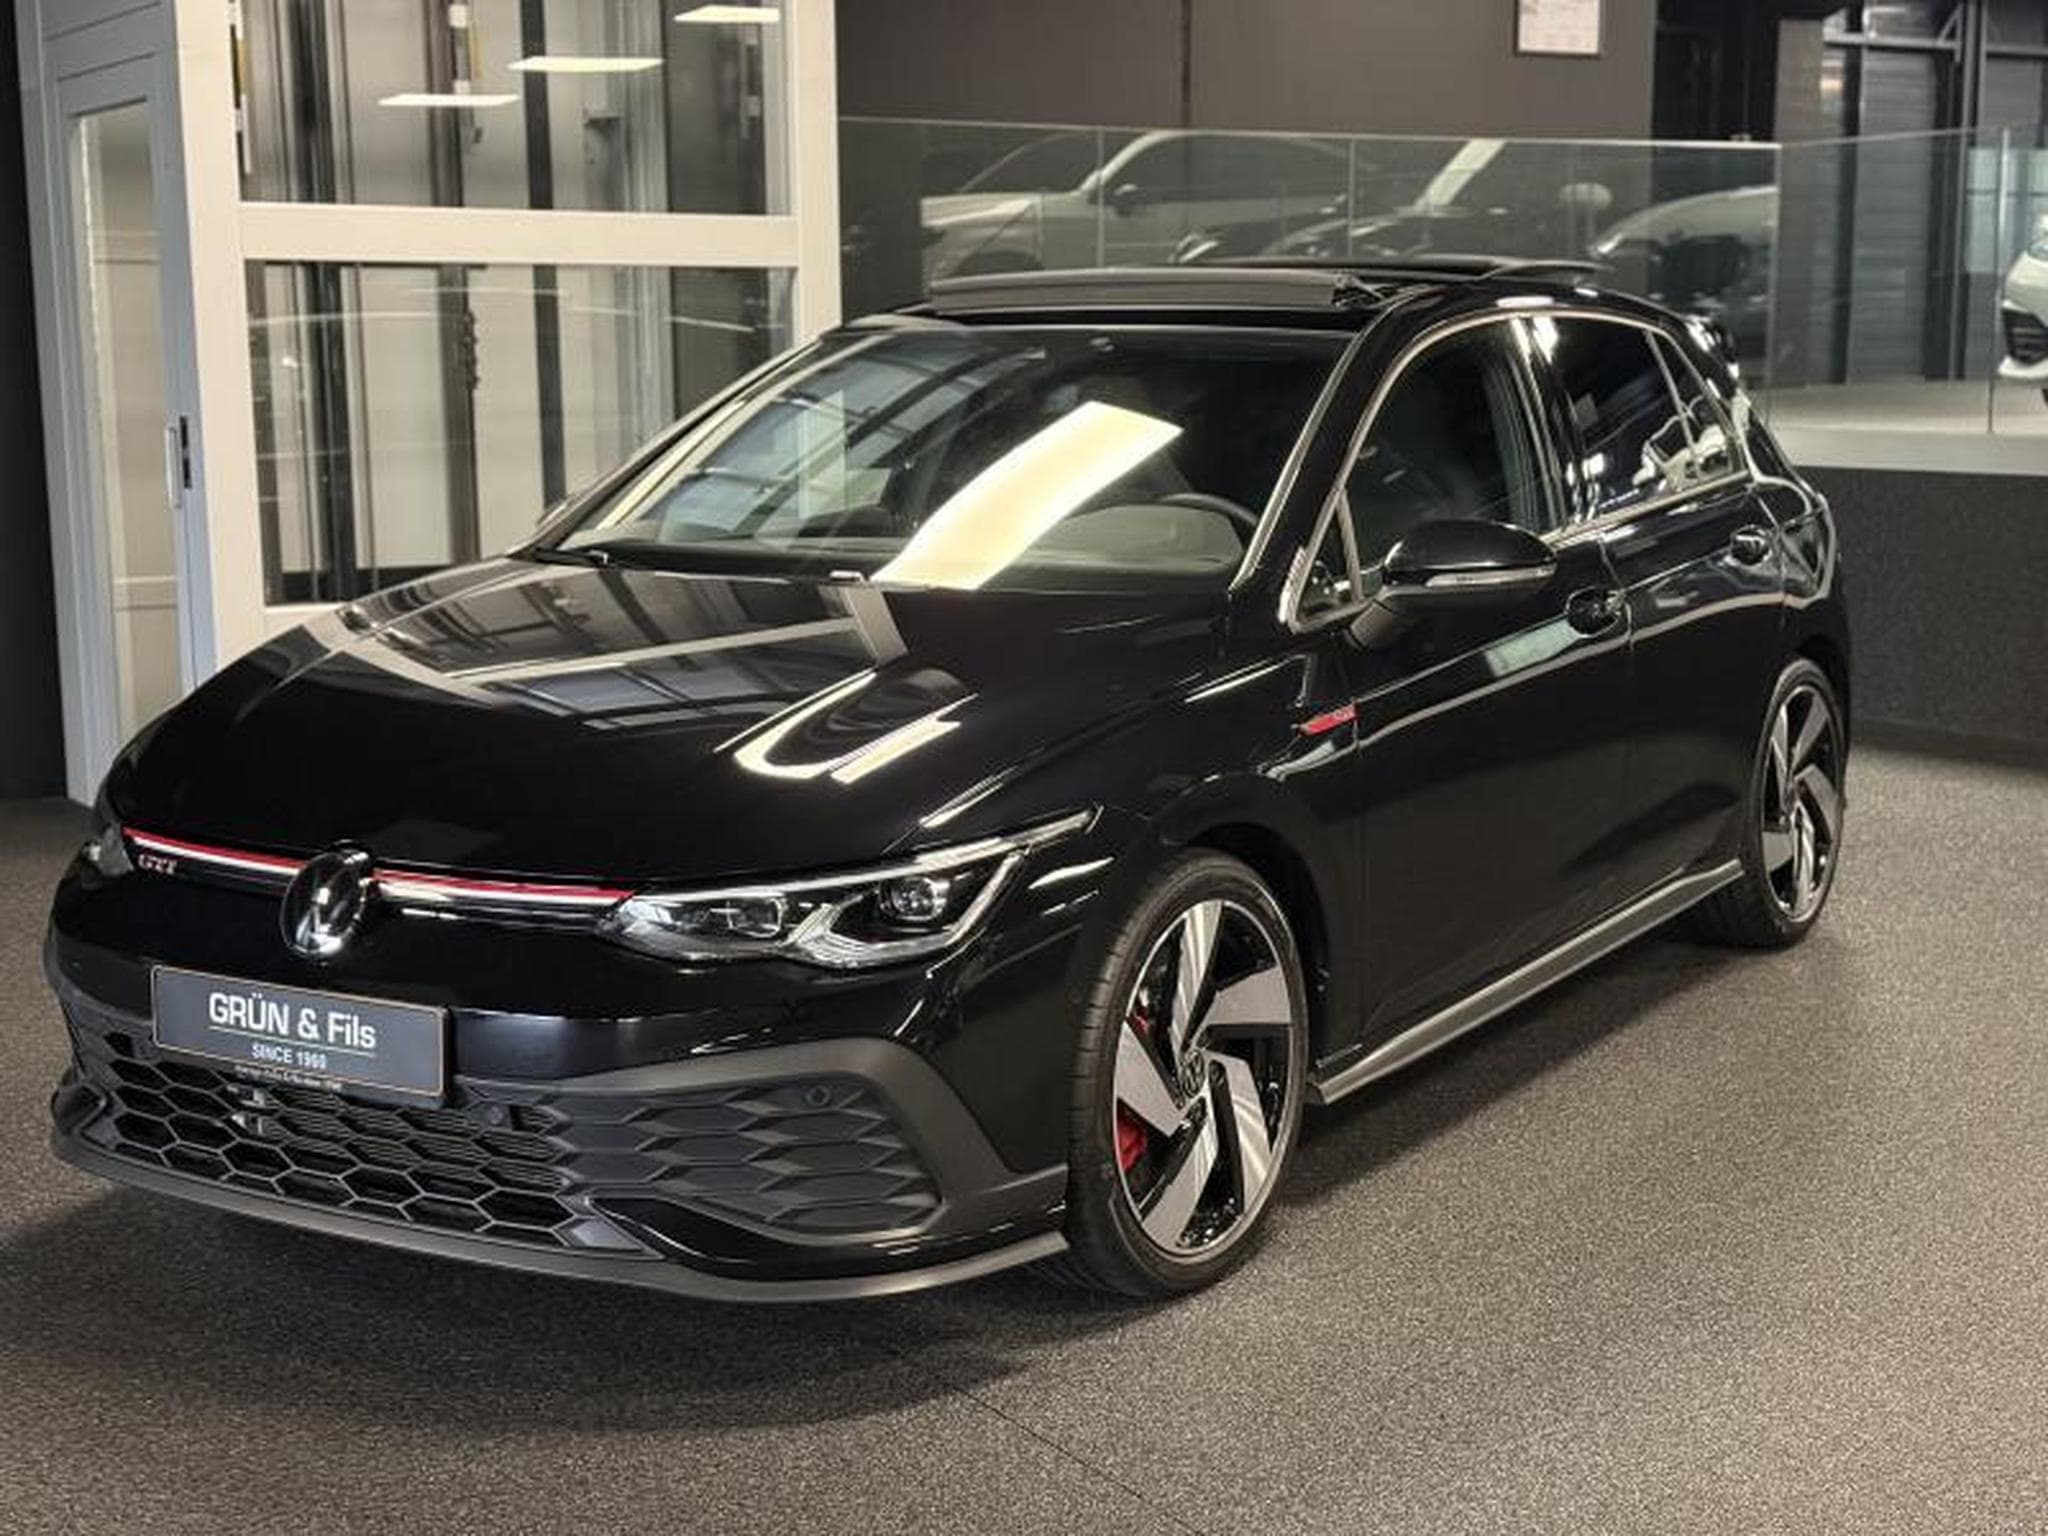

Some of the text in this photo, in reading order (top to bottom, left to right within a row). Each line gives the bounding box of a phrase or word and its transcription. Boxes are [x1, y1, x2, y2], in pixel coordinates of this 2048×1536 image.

[138, 854, 177, 875] GTI
[209, 992, 376, 1048] GRÜN & Fils
[252, 1043, 292, 1064] SINCE
